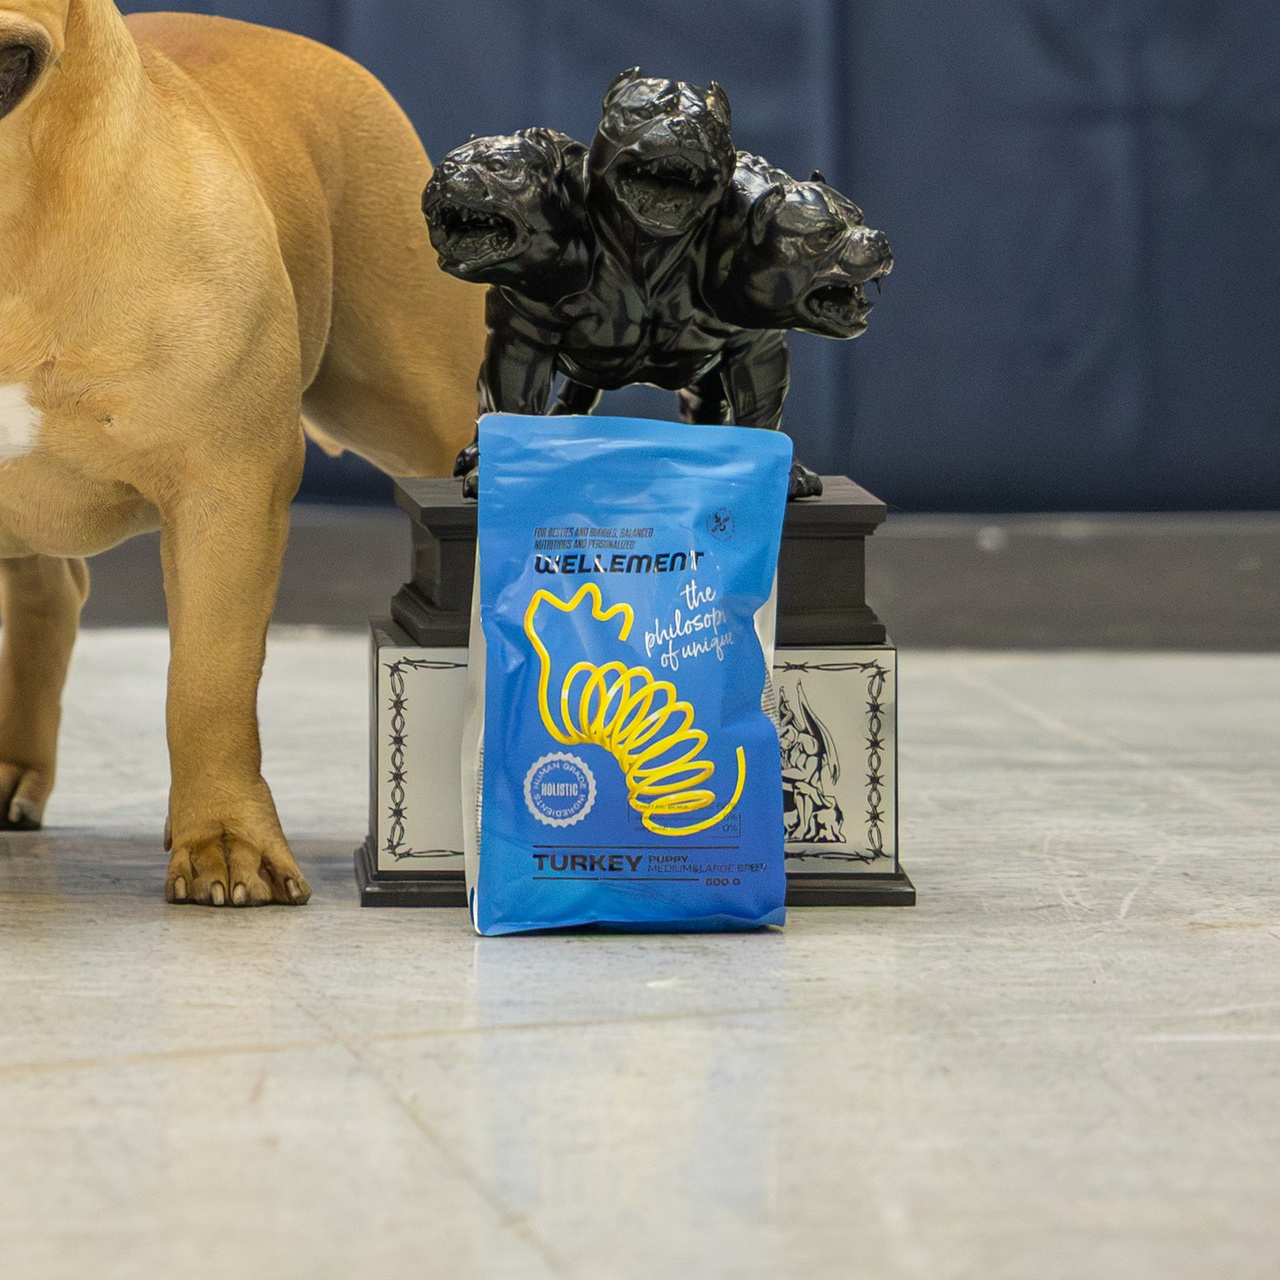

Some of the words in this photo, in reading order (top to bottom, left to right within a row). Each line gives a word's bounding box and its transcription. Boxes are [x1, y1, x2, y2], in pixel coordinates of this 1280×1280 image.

[534, 550, 705, 575] WELLEMENT
[680, 579, 717, 611] the
[660, 640, 680, 671] of
[541, 782, 579, 797] HOLISTIC
[532, 853, 643, 872] TURKEY
[648, 854, 689, 864] PUPPY
